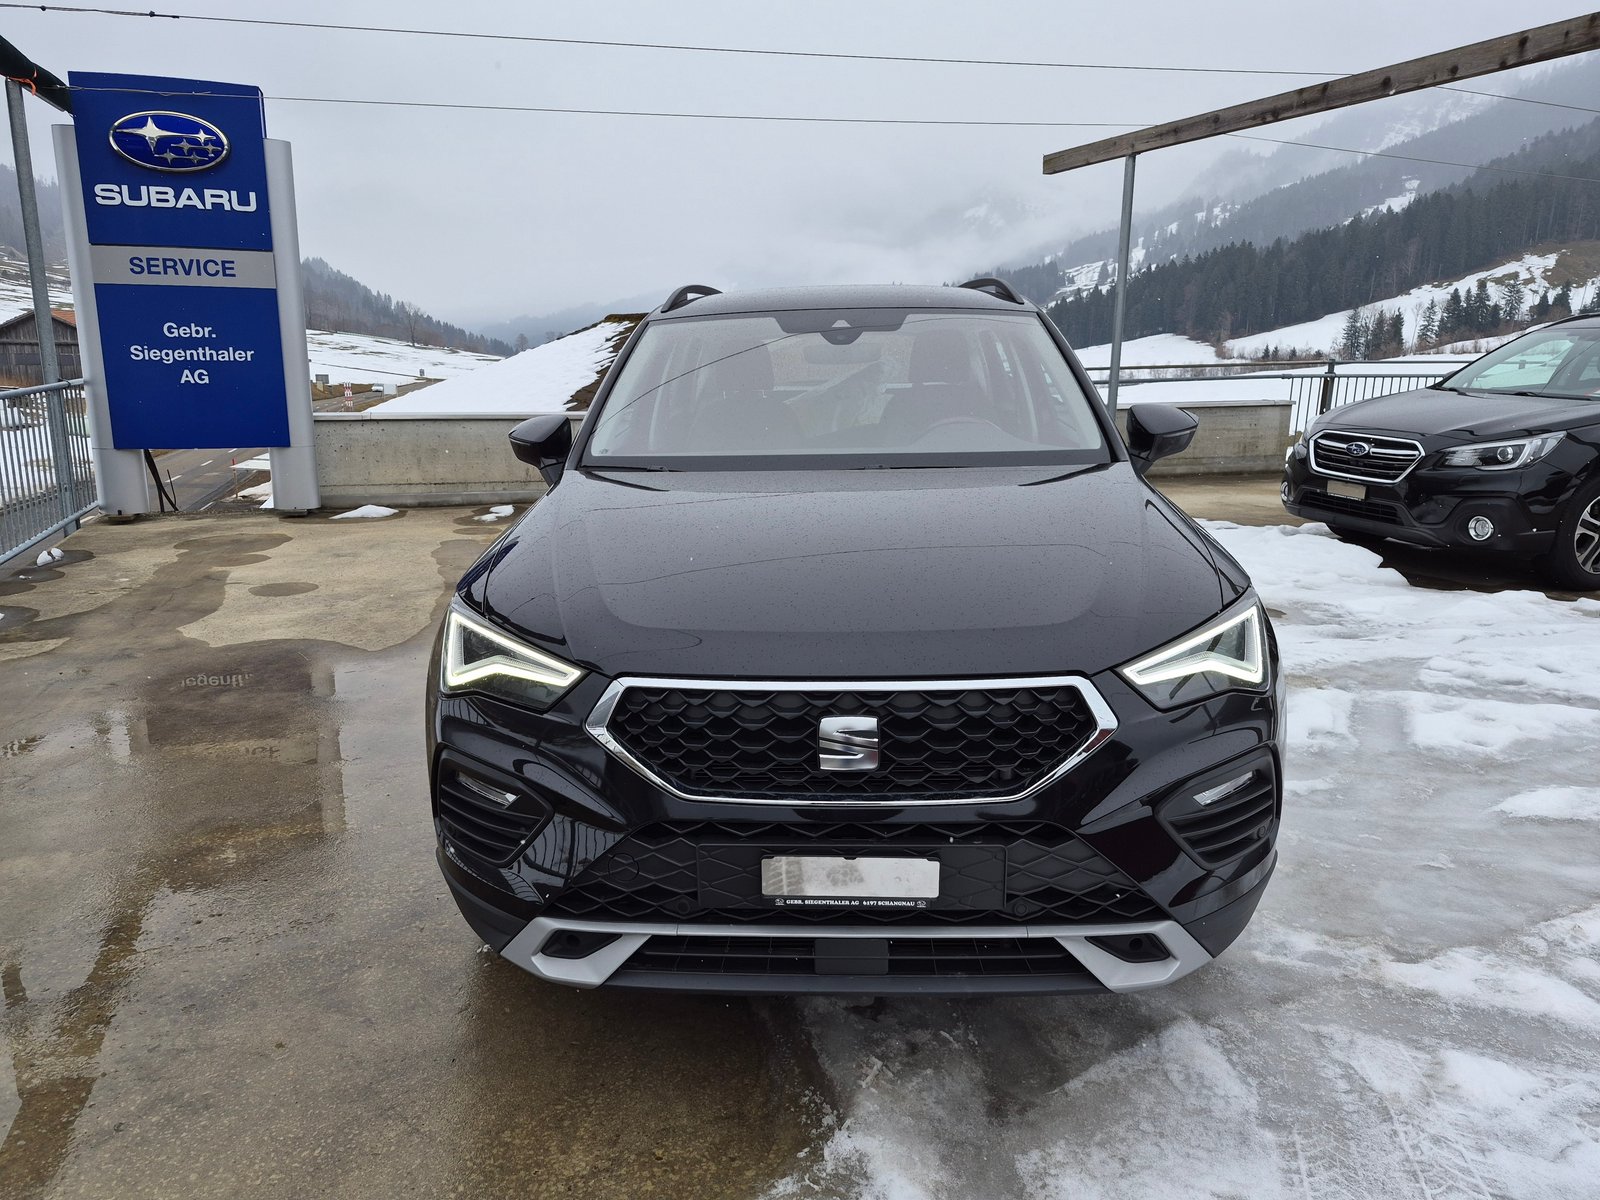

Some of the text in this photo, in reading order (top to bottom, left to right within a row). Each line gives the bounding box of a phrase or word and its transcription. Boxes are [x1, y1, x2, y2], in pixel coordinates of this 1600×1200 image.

[95, 183, 257, 213] SUBARU
[129, 256, 237, 278] SERVICE
[163, 322, 217, 339] Gebr.
[130, 345, 255, 364] Siegenthaler
[180, 369, 210, 385] AG
